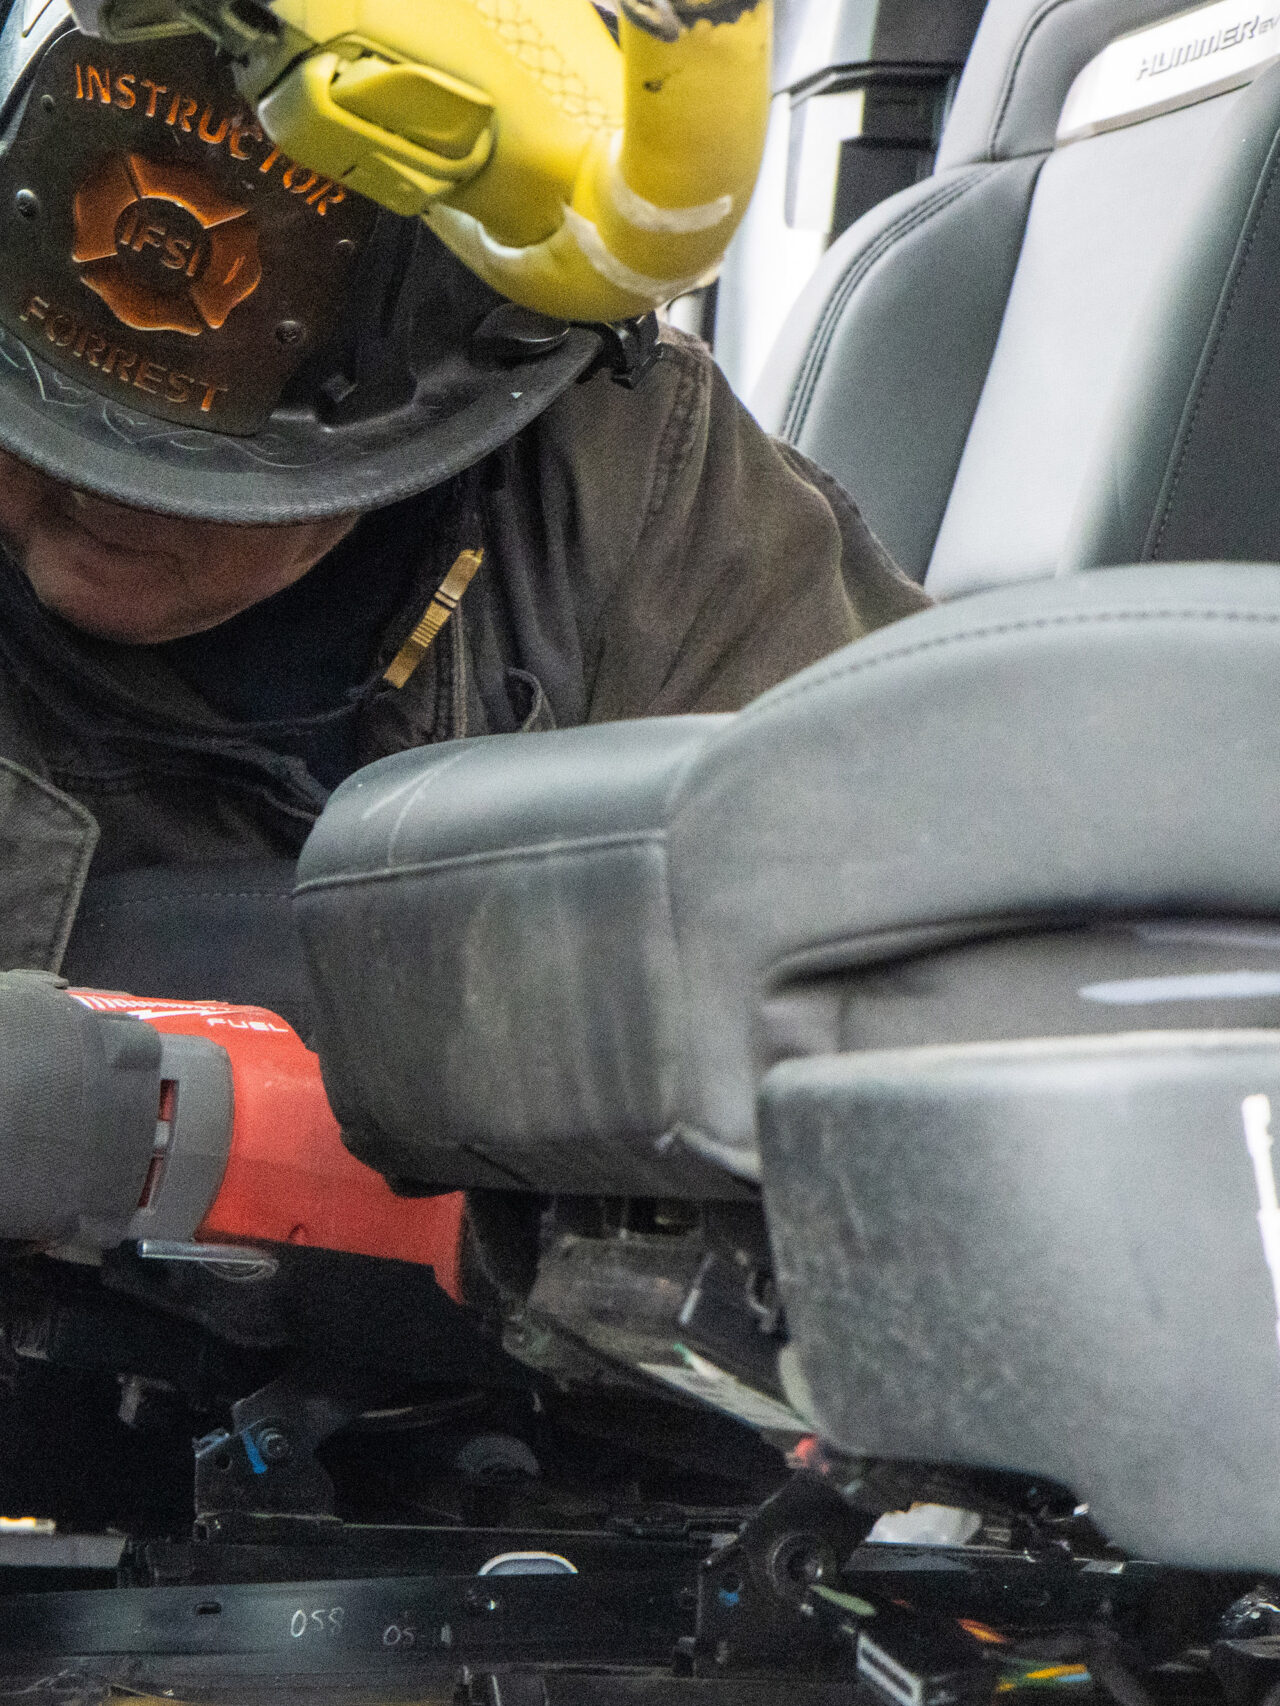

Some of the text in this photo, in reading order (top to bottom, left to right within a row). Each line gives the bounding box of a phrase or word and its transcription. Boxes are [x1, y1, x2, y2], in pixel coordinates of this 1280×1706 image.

[1136, 15, 1260, 81] HUMMER
[74, 63, 348, 216] INSTRUCTOR
[120, 216, 203, 277] IFSI
[20, 295, 228, 413] FORREST
[206, 1017, 289, 1033] FUEL
